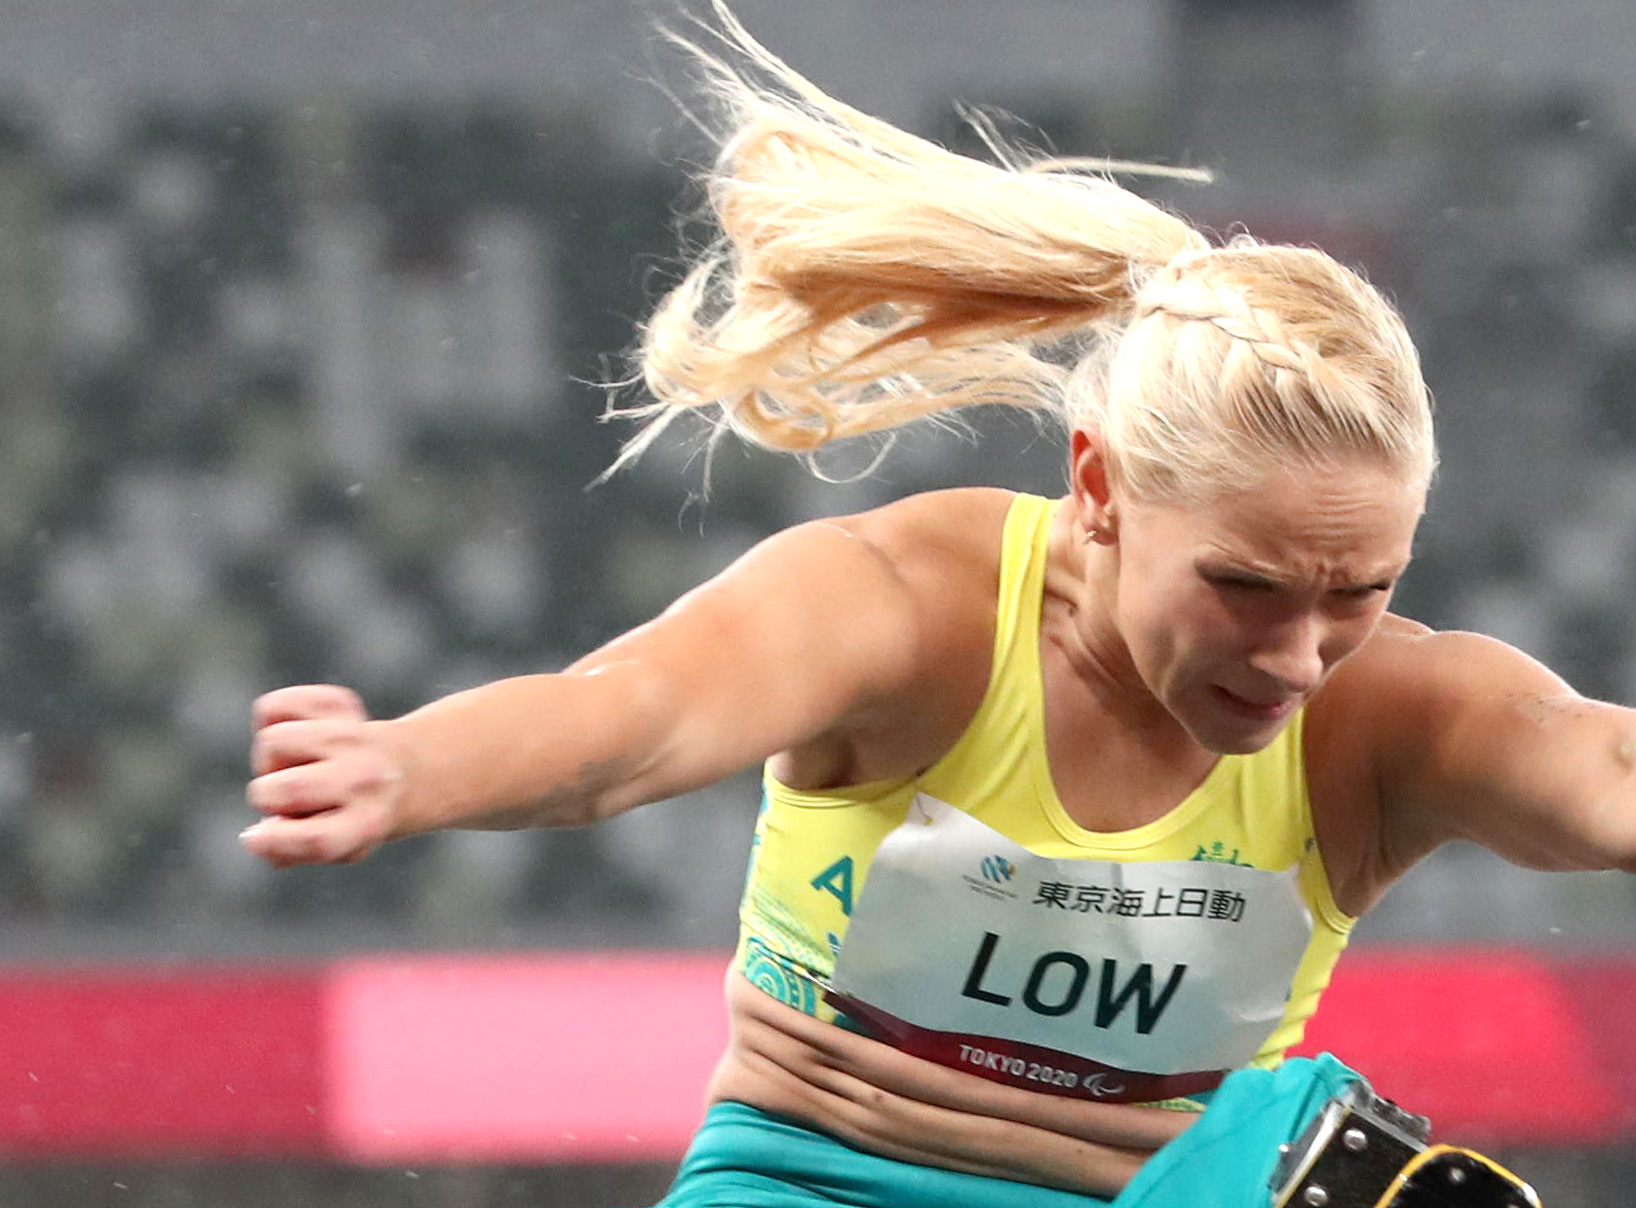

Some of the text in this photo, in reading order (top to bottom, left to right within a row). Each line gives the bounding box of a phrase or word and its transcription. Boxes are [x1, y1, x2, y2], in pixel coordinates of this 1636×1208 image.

[1033, 880, 1247, 923] 東京海上日動
[960, 931, 1187, 1035] LOW
[958, 1043, 1079, 1088] TOKYO 2020
